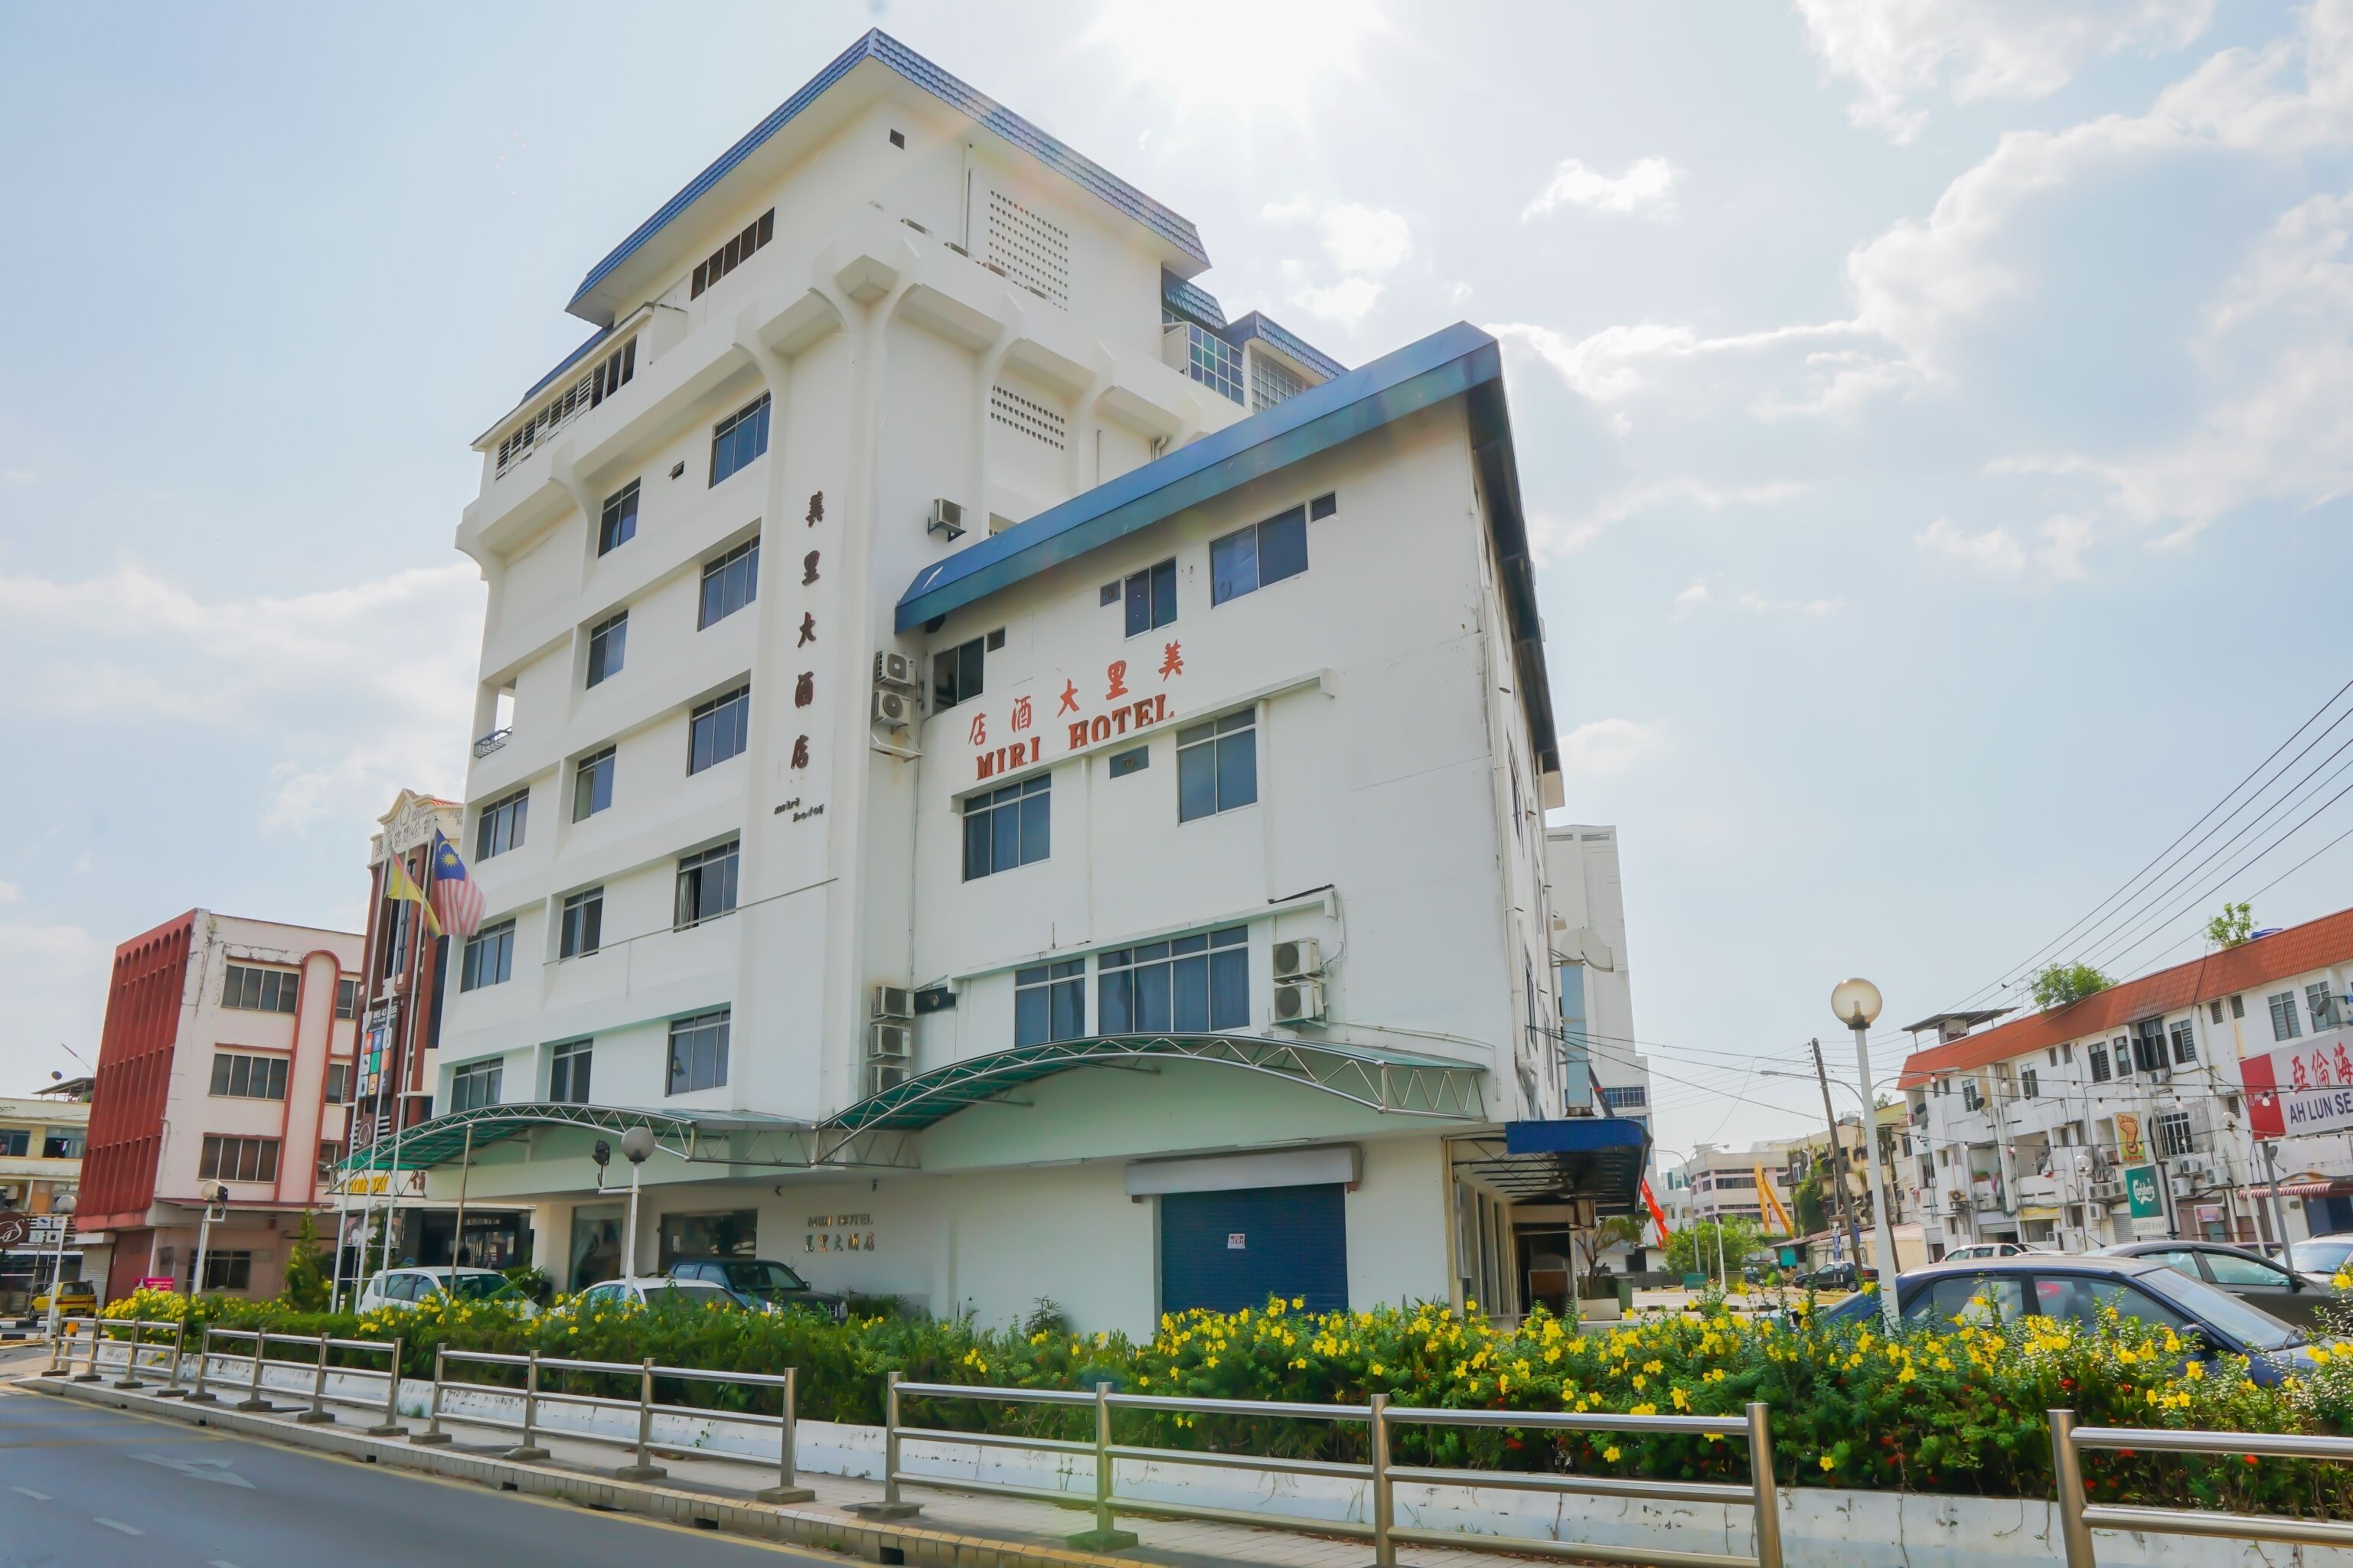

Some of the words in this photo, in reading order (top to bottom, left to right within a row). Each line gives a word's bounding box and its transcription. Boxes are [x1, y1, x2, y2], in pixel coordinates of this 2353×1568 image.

[976, 736, 1041, 781] MIRI
[1068, 693, 1175, 751] HOTEL
[2289, 1101, 2307, 1125] AH
[2307, 1096, 2334, 1121] LUN
[2335, 1091, 2353, 1116] SE
[2133, 1178, 2156, 1201] Carlsberg
